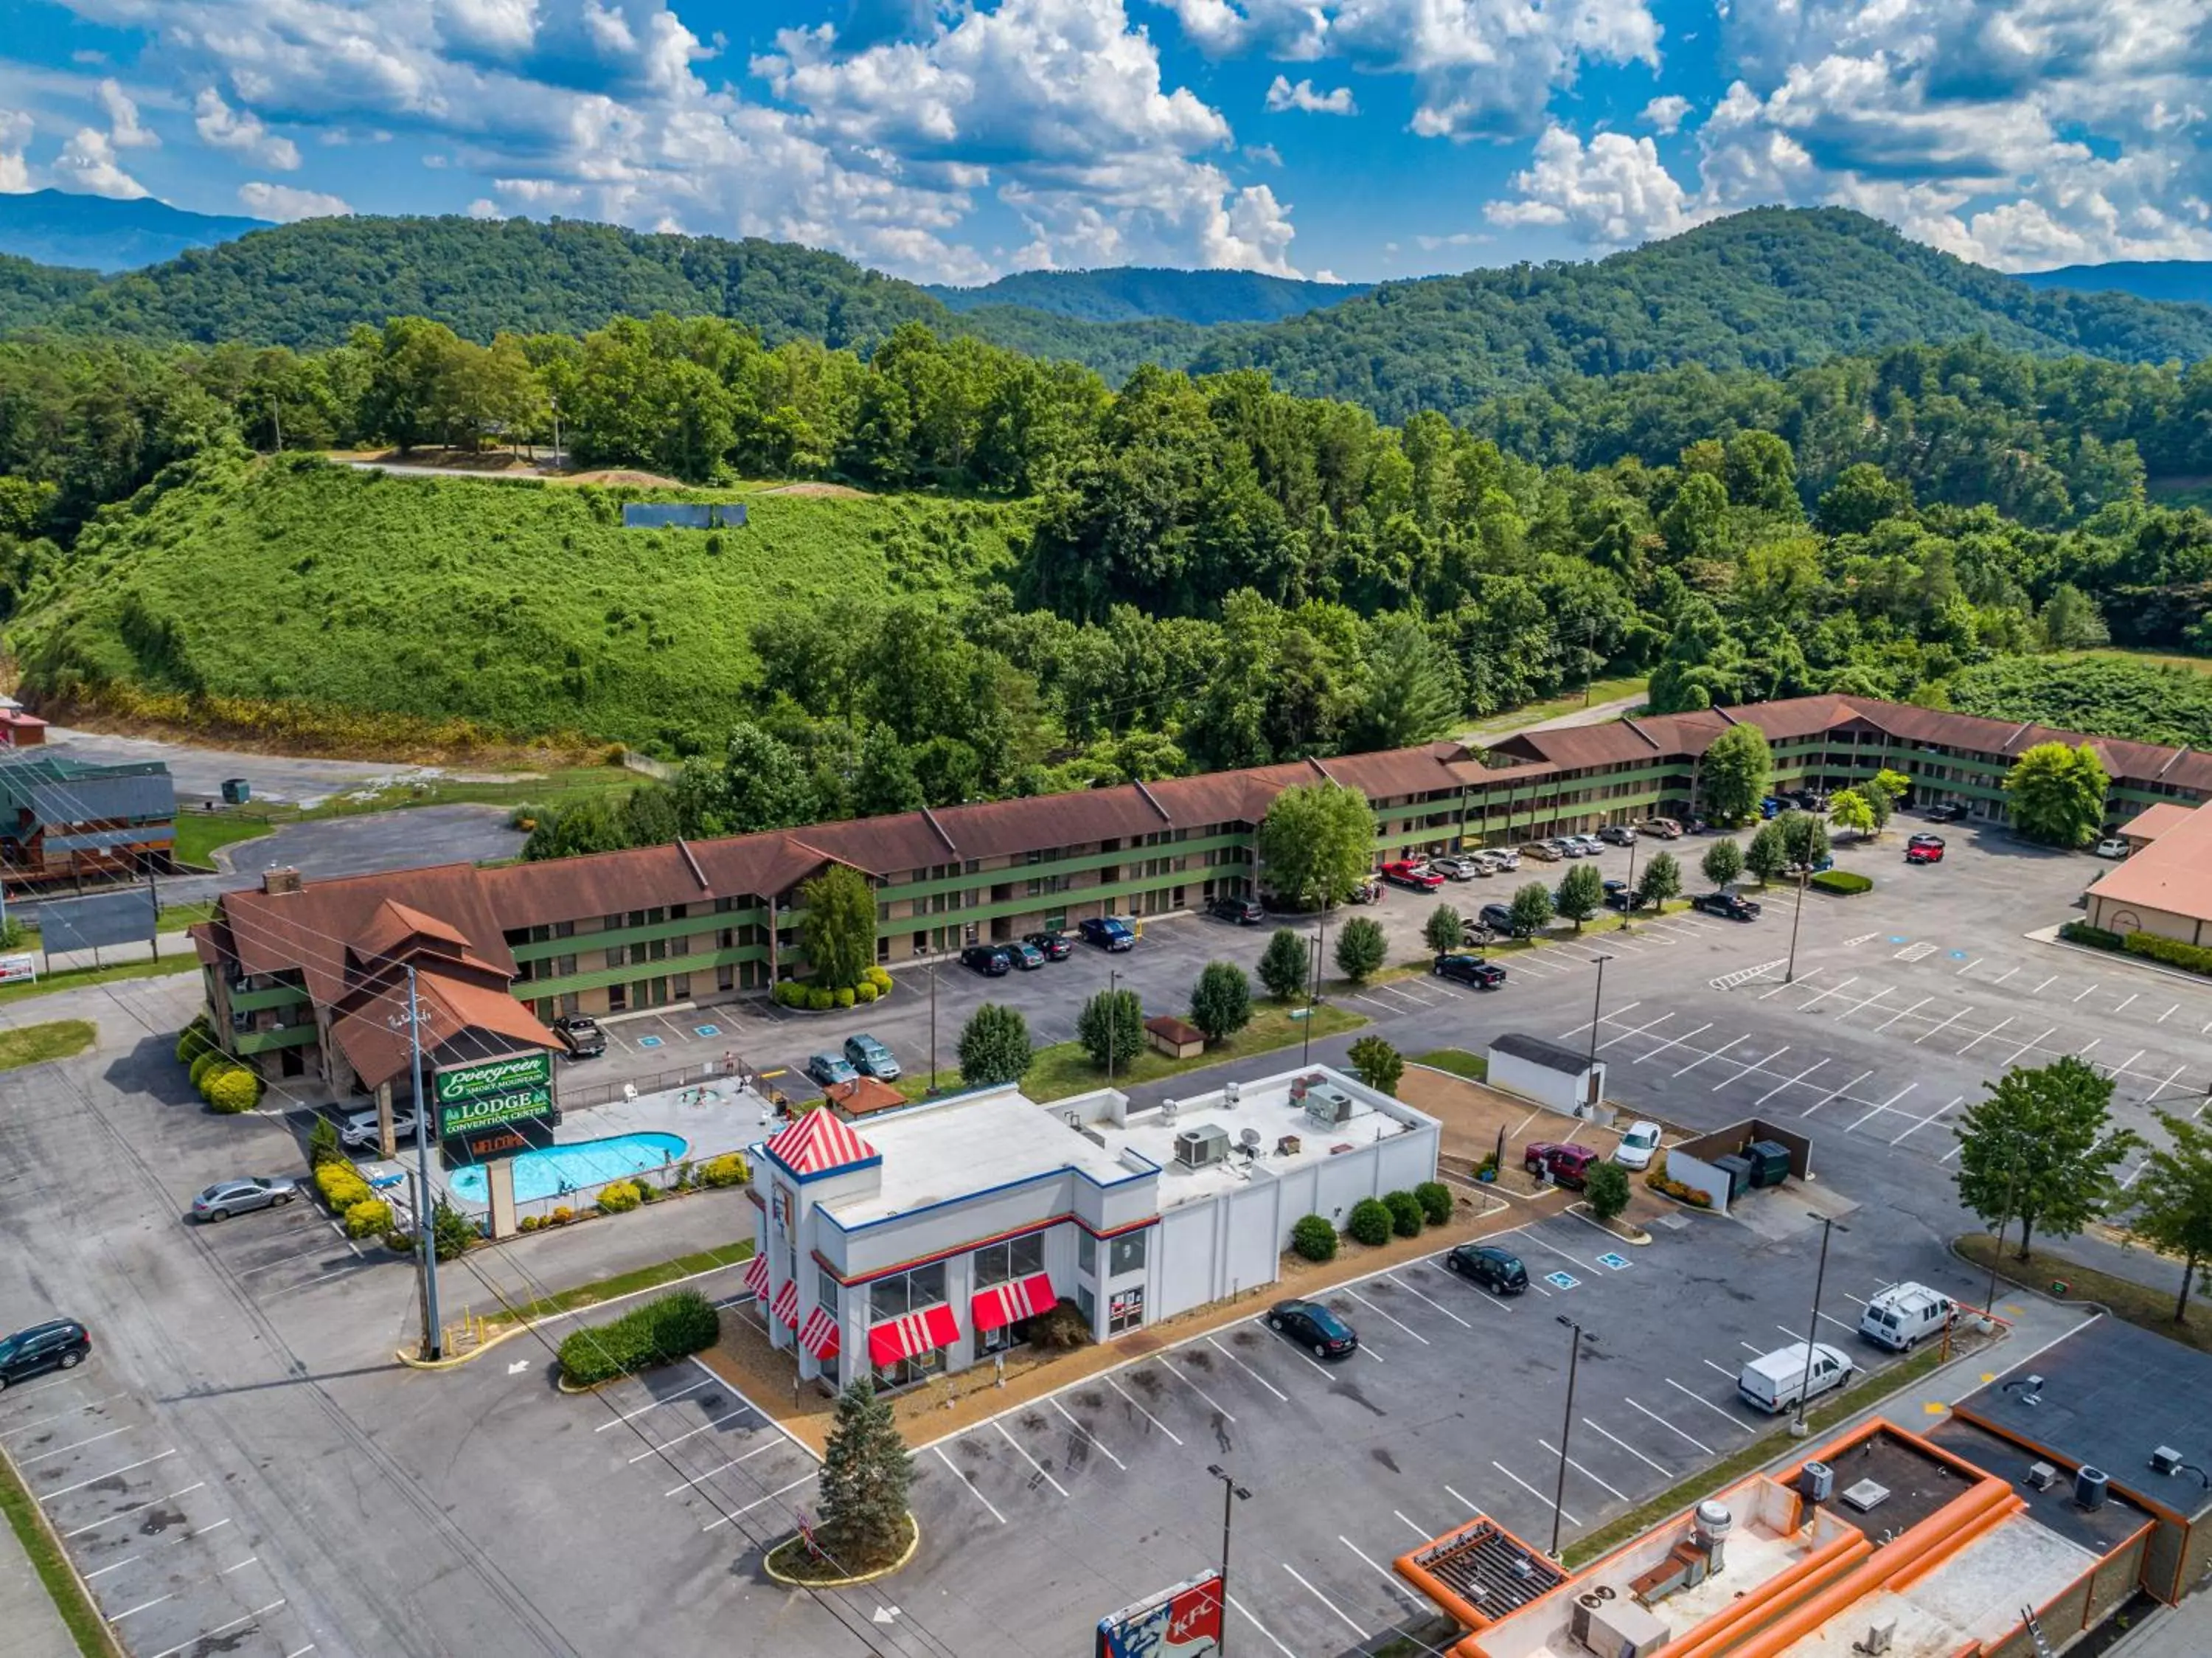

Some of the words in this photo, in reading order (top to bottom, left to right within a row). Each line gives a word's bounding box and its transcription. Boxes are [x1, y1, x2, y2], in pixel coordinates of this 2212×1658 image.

[442, 1059, 542, 1097] Evergreen
[466, 1083, 498, 1095] SMOKY
[498, 1073, 543, 1087] MOUNTAIN
[462, 1092, 532, 1118] LODGE
[446, 1116, 509, 1134] CONVENTION
[511, 1106, 547, 1120] CENTER
[472, 1133, 526, 1156] WELCOME
[1173, 1598, 1214, 1637] KFC
